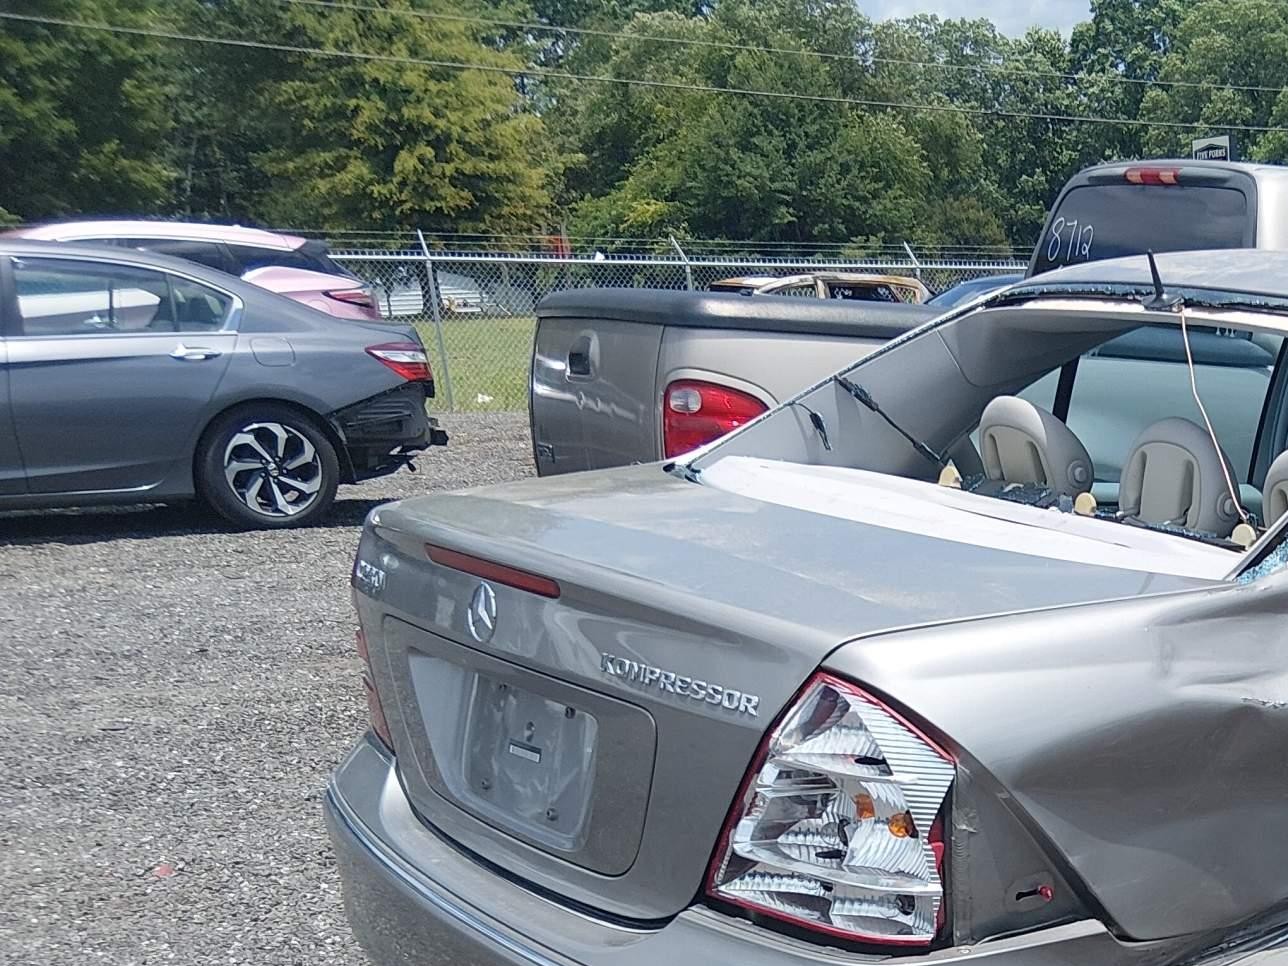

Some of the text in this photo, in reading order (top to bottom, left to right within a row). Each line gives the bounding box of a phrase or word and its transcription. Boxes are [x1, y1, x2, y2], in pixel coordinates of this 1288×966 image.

[1209, 148, 1226, 159] FORKS
[1047, 216, 1094, 262] 8712
[600, 652, 760, 718] KOMPRESSOR
